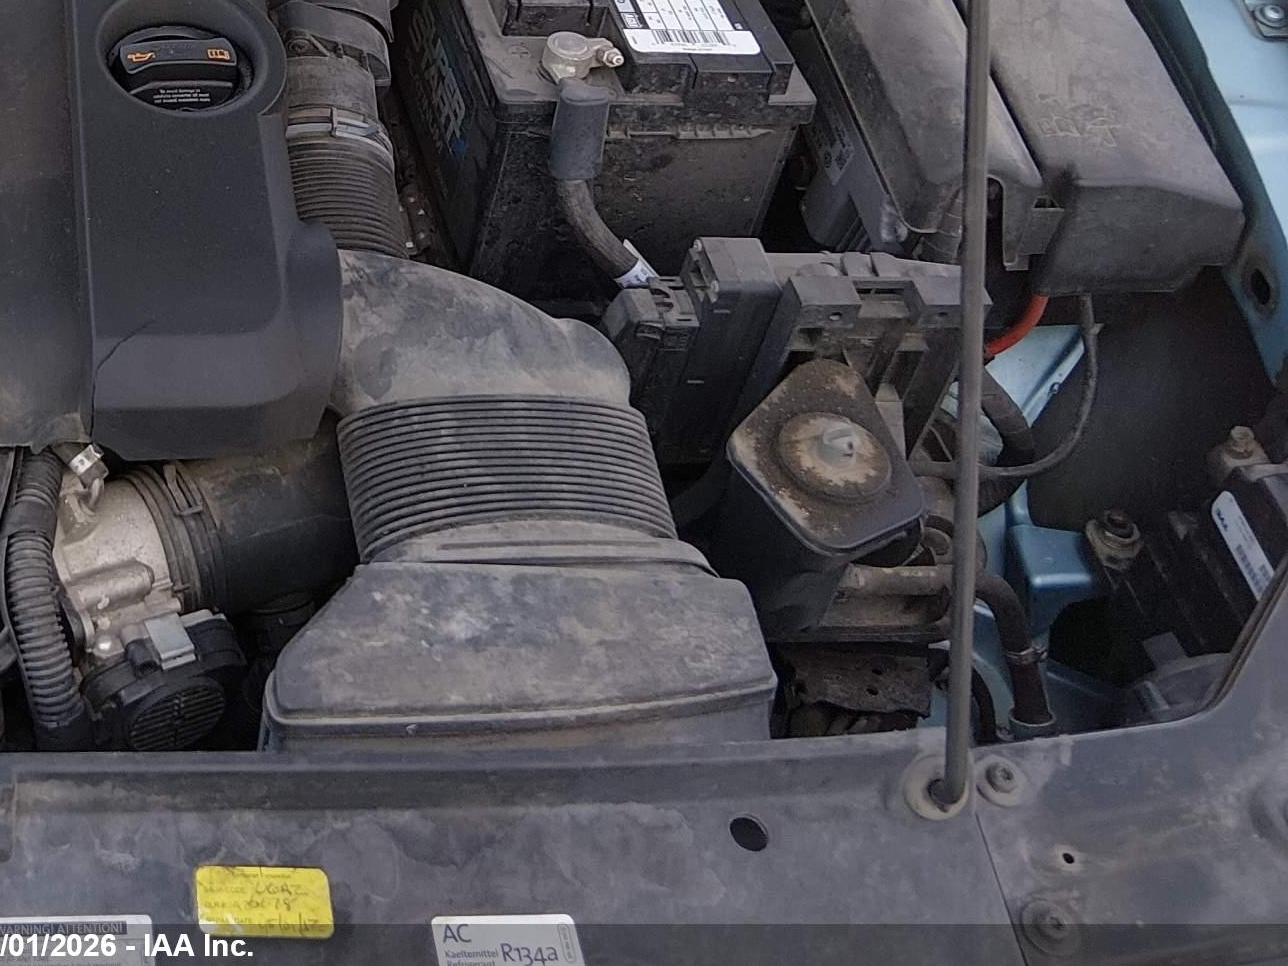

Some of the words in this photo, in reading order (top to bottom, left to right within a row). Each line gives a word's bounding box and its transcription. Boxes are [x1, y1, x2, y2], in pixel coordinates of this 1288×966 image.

[57, 922, 122, 934] ATTENTION!
[443, 923, 472, 943] AC
[444, 948, 499, 959] Kaeltemittel
[500, 942, 559, 966] R134a
